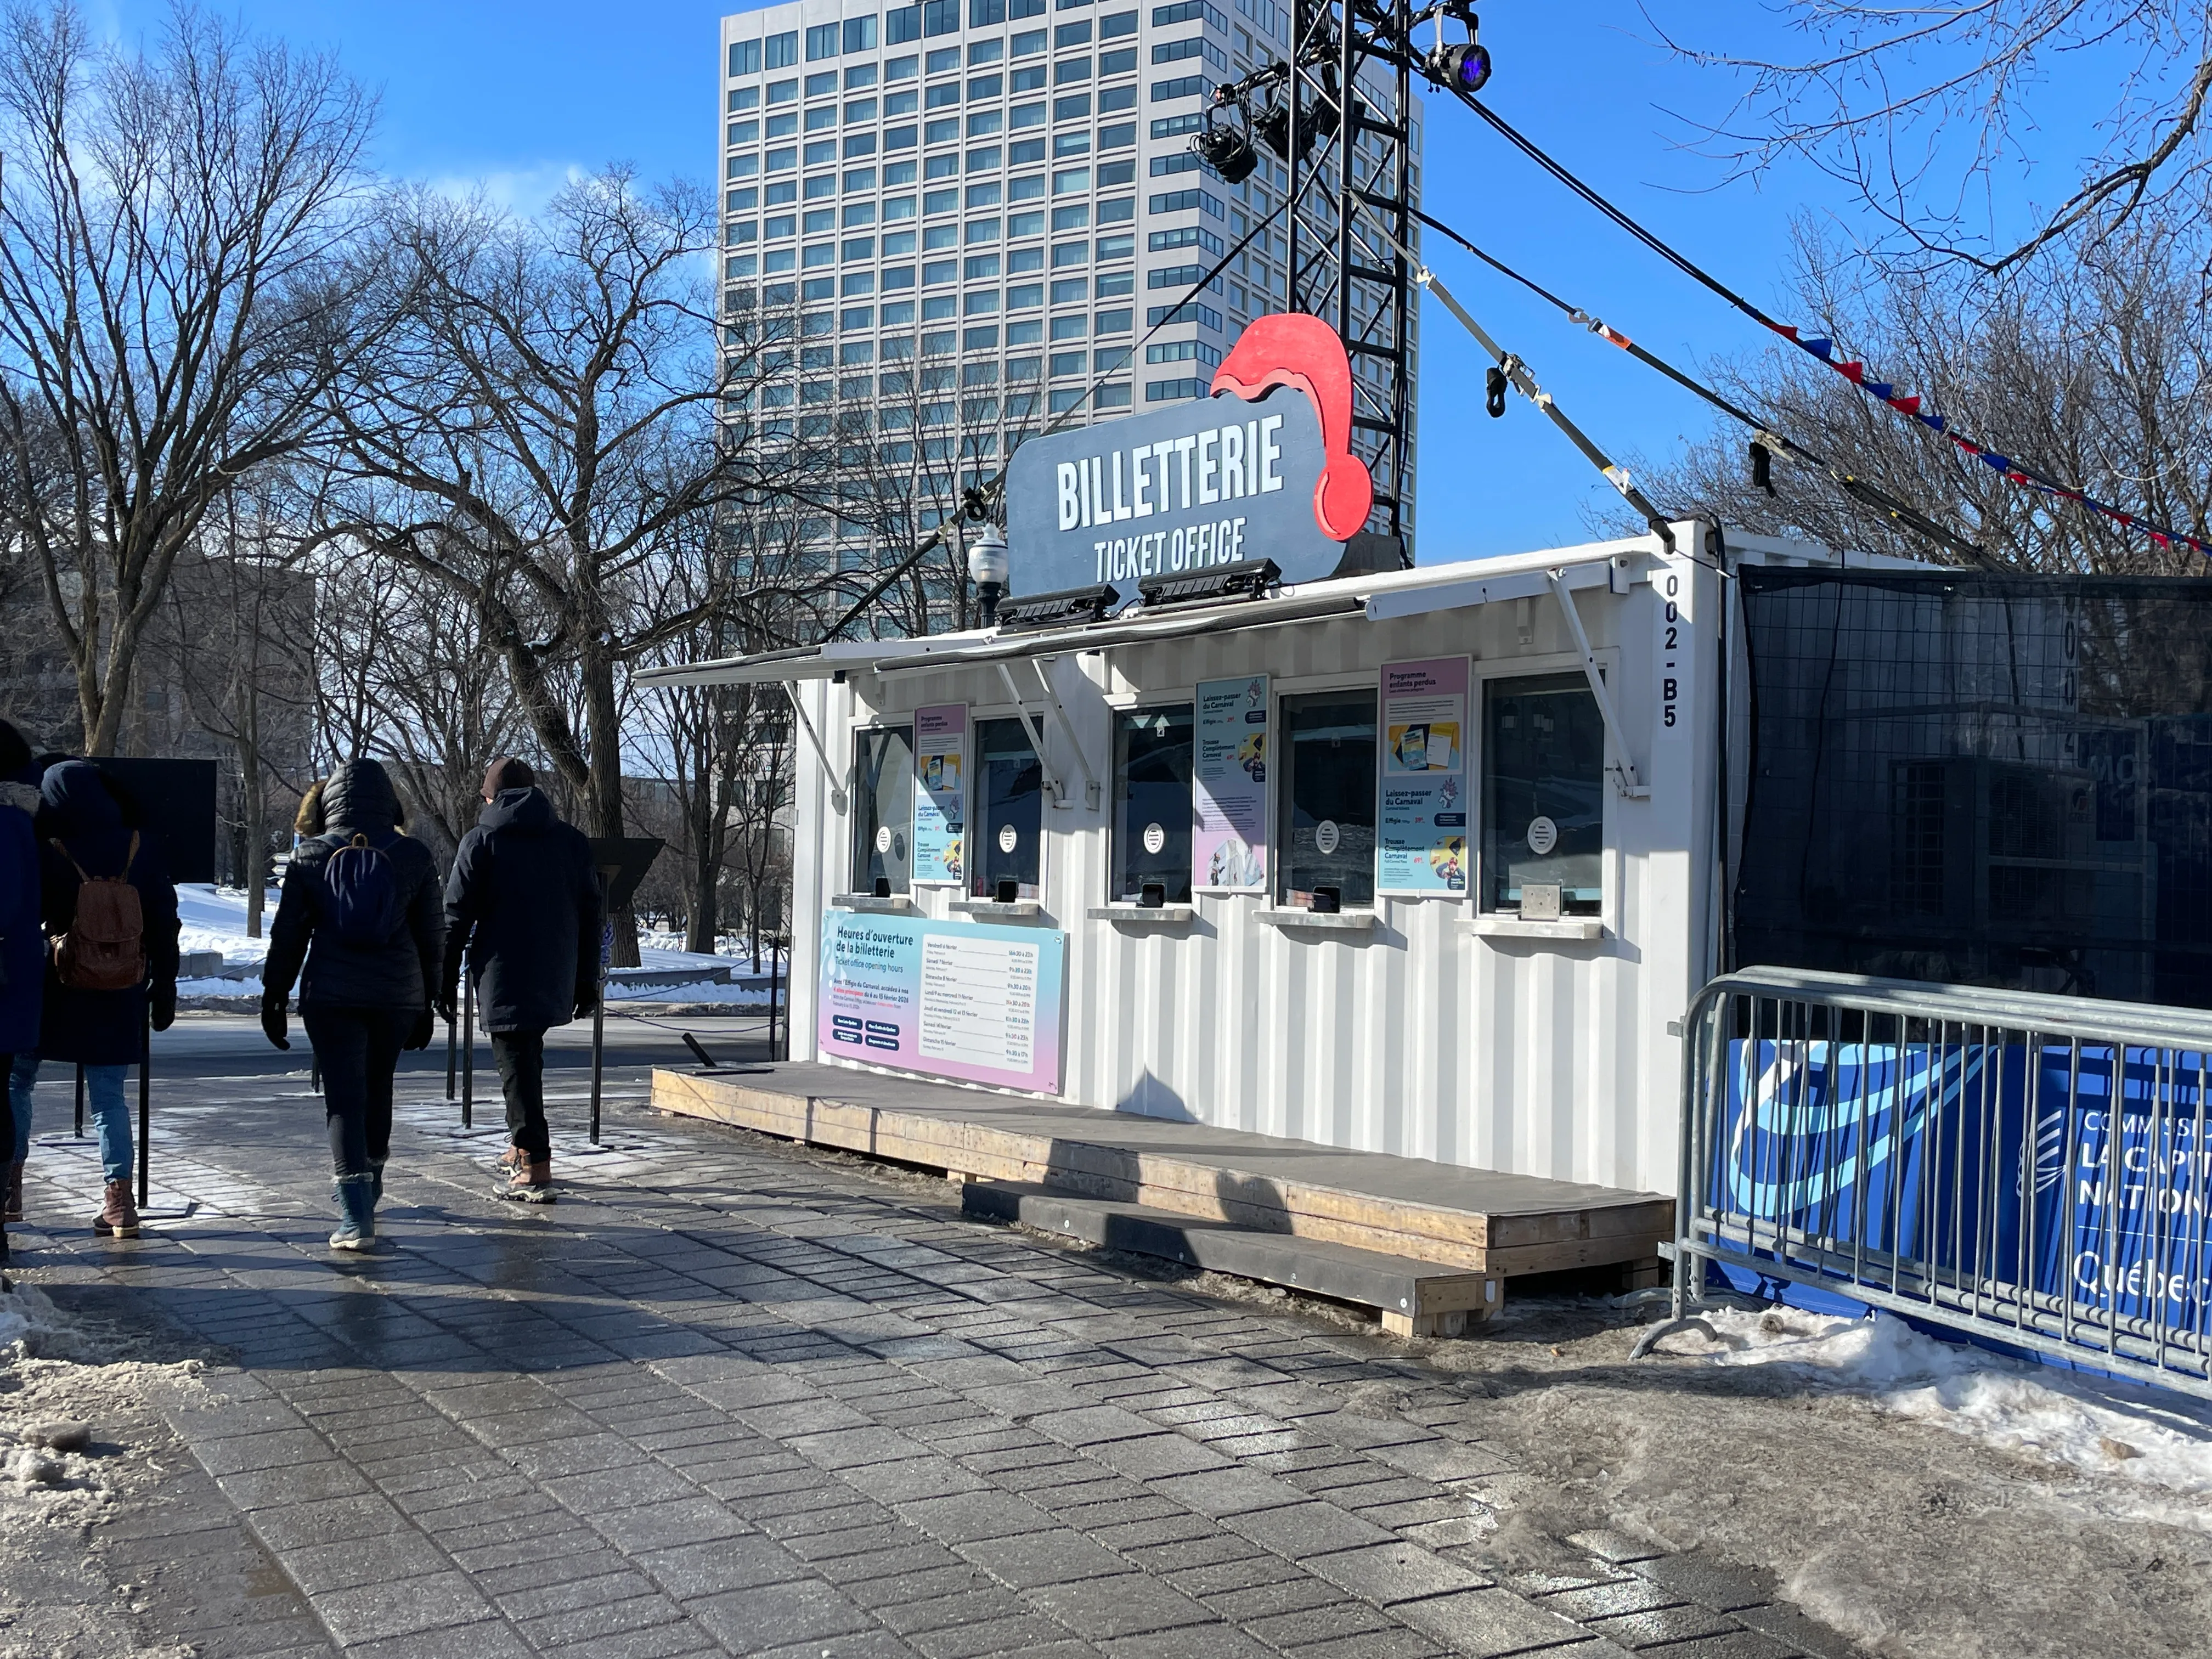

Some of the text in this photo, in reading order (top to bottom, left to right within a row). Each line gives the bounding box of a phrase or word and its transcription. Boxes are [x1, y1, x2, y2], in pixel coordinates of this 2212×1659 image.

[1058, 414, 1284, 531] BILLETTERIE
[1094, 517, 1246, 583] TICKET OFFICE
[1390, 672, 1426, 680] Programme
[1414, 679, 1436, 688] perdus
[1203, 693, 1241, 702] Laissez-passer
[837, 926, 913, 946] Heures d'ouverture
[836, 940, 895, 958] de la billetterie
[835, 957, 904, 973] Ticket office opening hours
[2079, 1180, 2212, 1218] NATION
[2074, 1250, 2211, 1306] Québec
